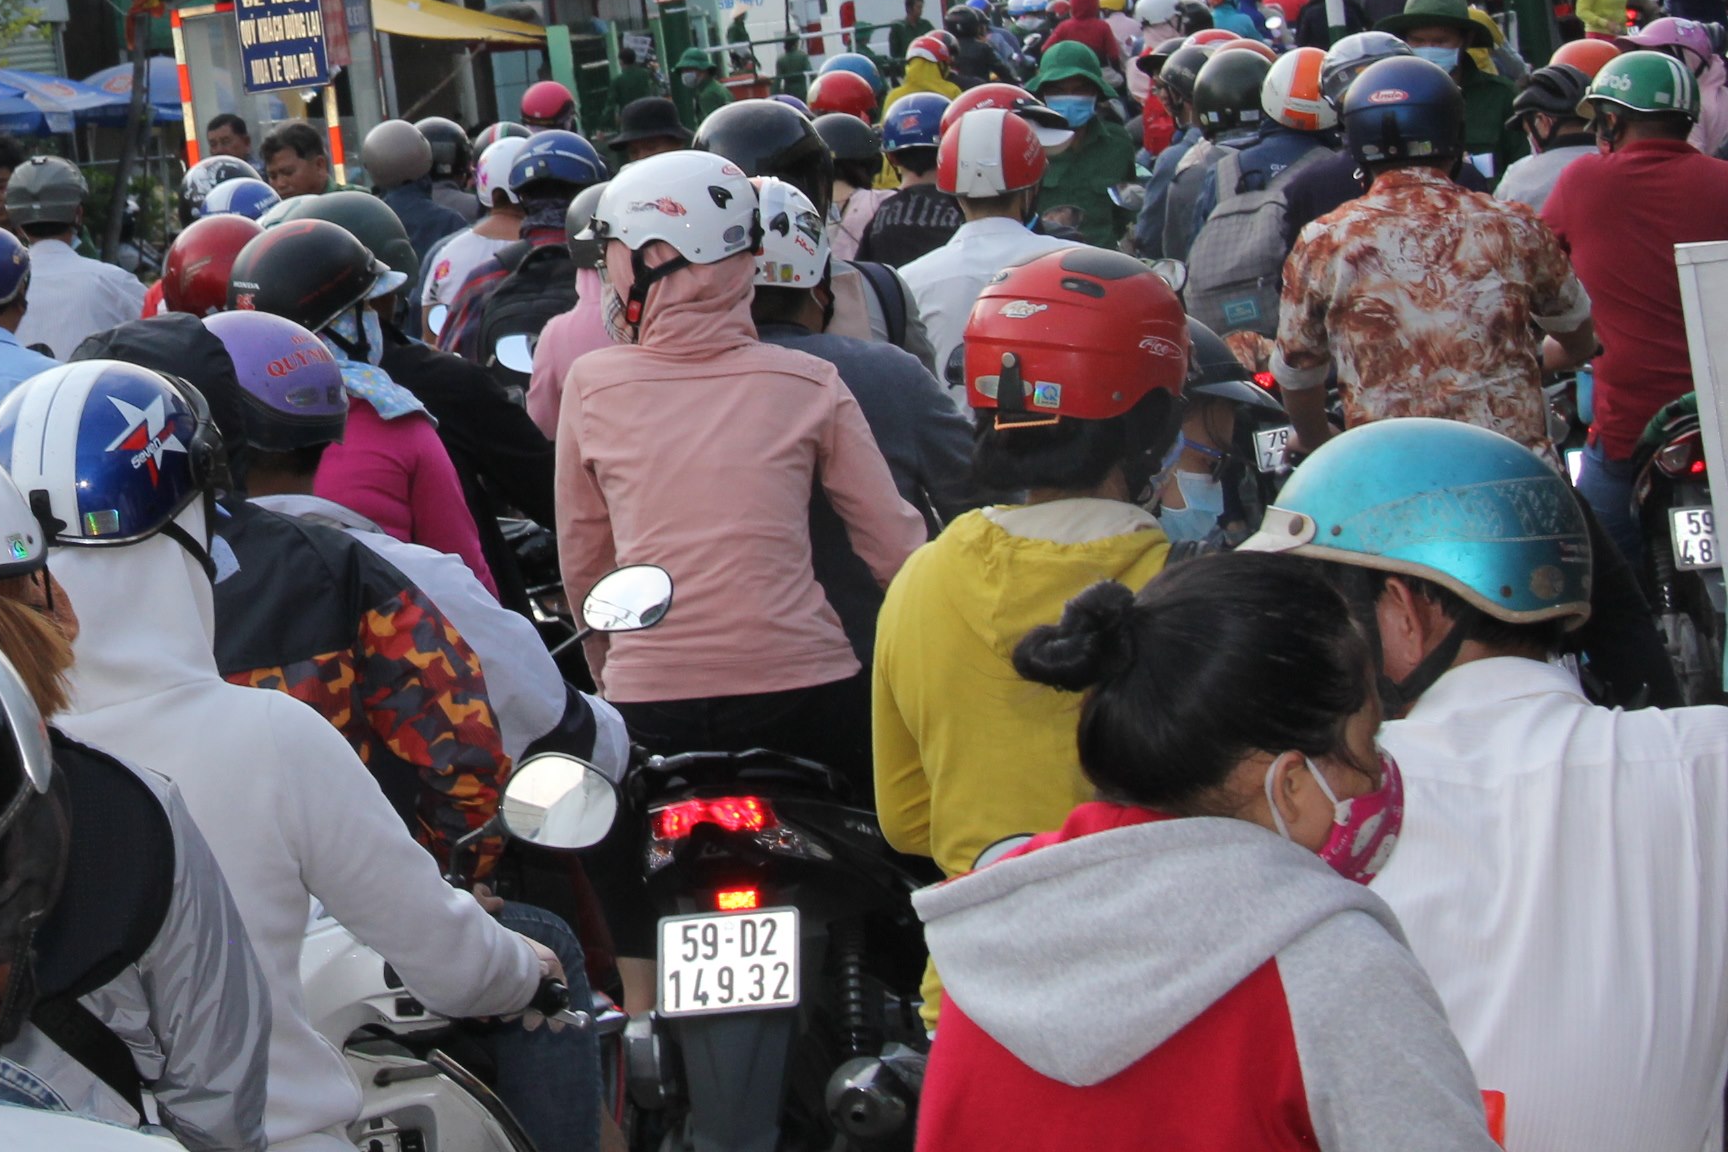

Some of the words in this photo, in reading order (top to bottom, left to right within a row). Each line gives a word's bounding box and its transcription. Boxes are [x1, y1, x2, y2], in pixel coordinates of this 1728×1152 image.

[131, 437, 162, 469] Seven
[681, 917, 778, 963] 59-D2
[669, 961, 790, 1009] 149.32
